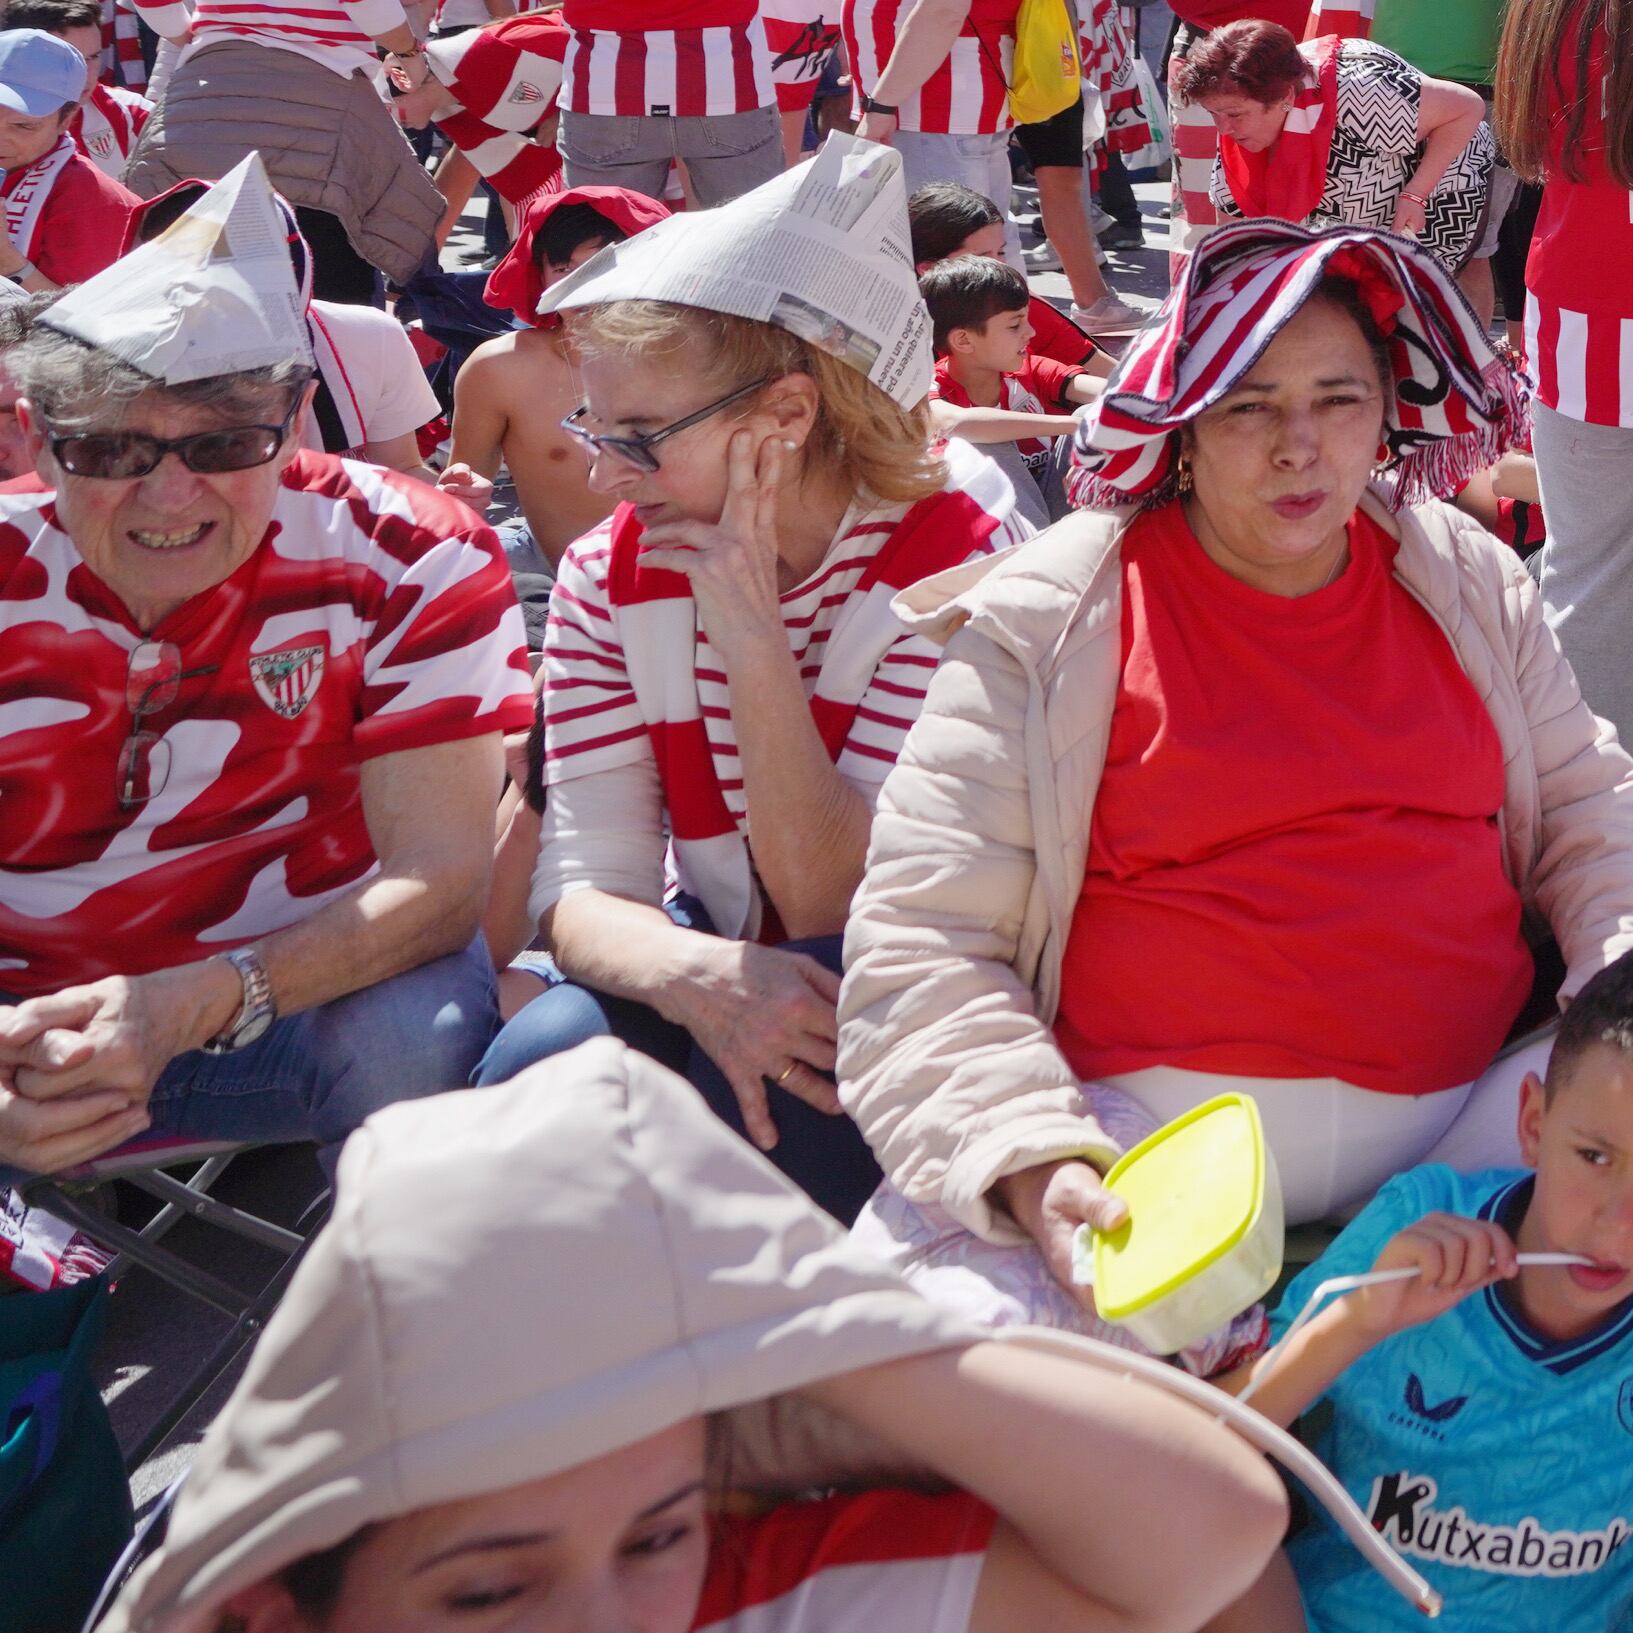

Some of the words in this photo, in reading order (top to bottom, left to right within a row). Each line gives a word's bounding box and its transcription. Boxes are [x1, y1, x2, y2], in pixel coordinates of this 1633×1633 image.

[899, 317, 918, 341] año
[891, 339, 907, 357] un
[893, 337, 920, 377] quiere
